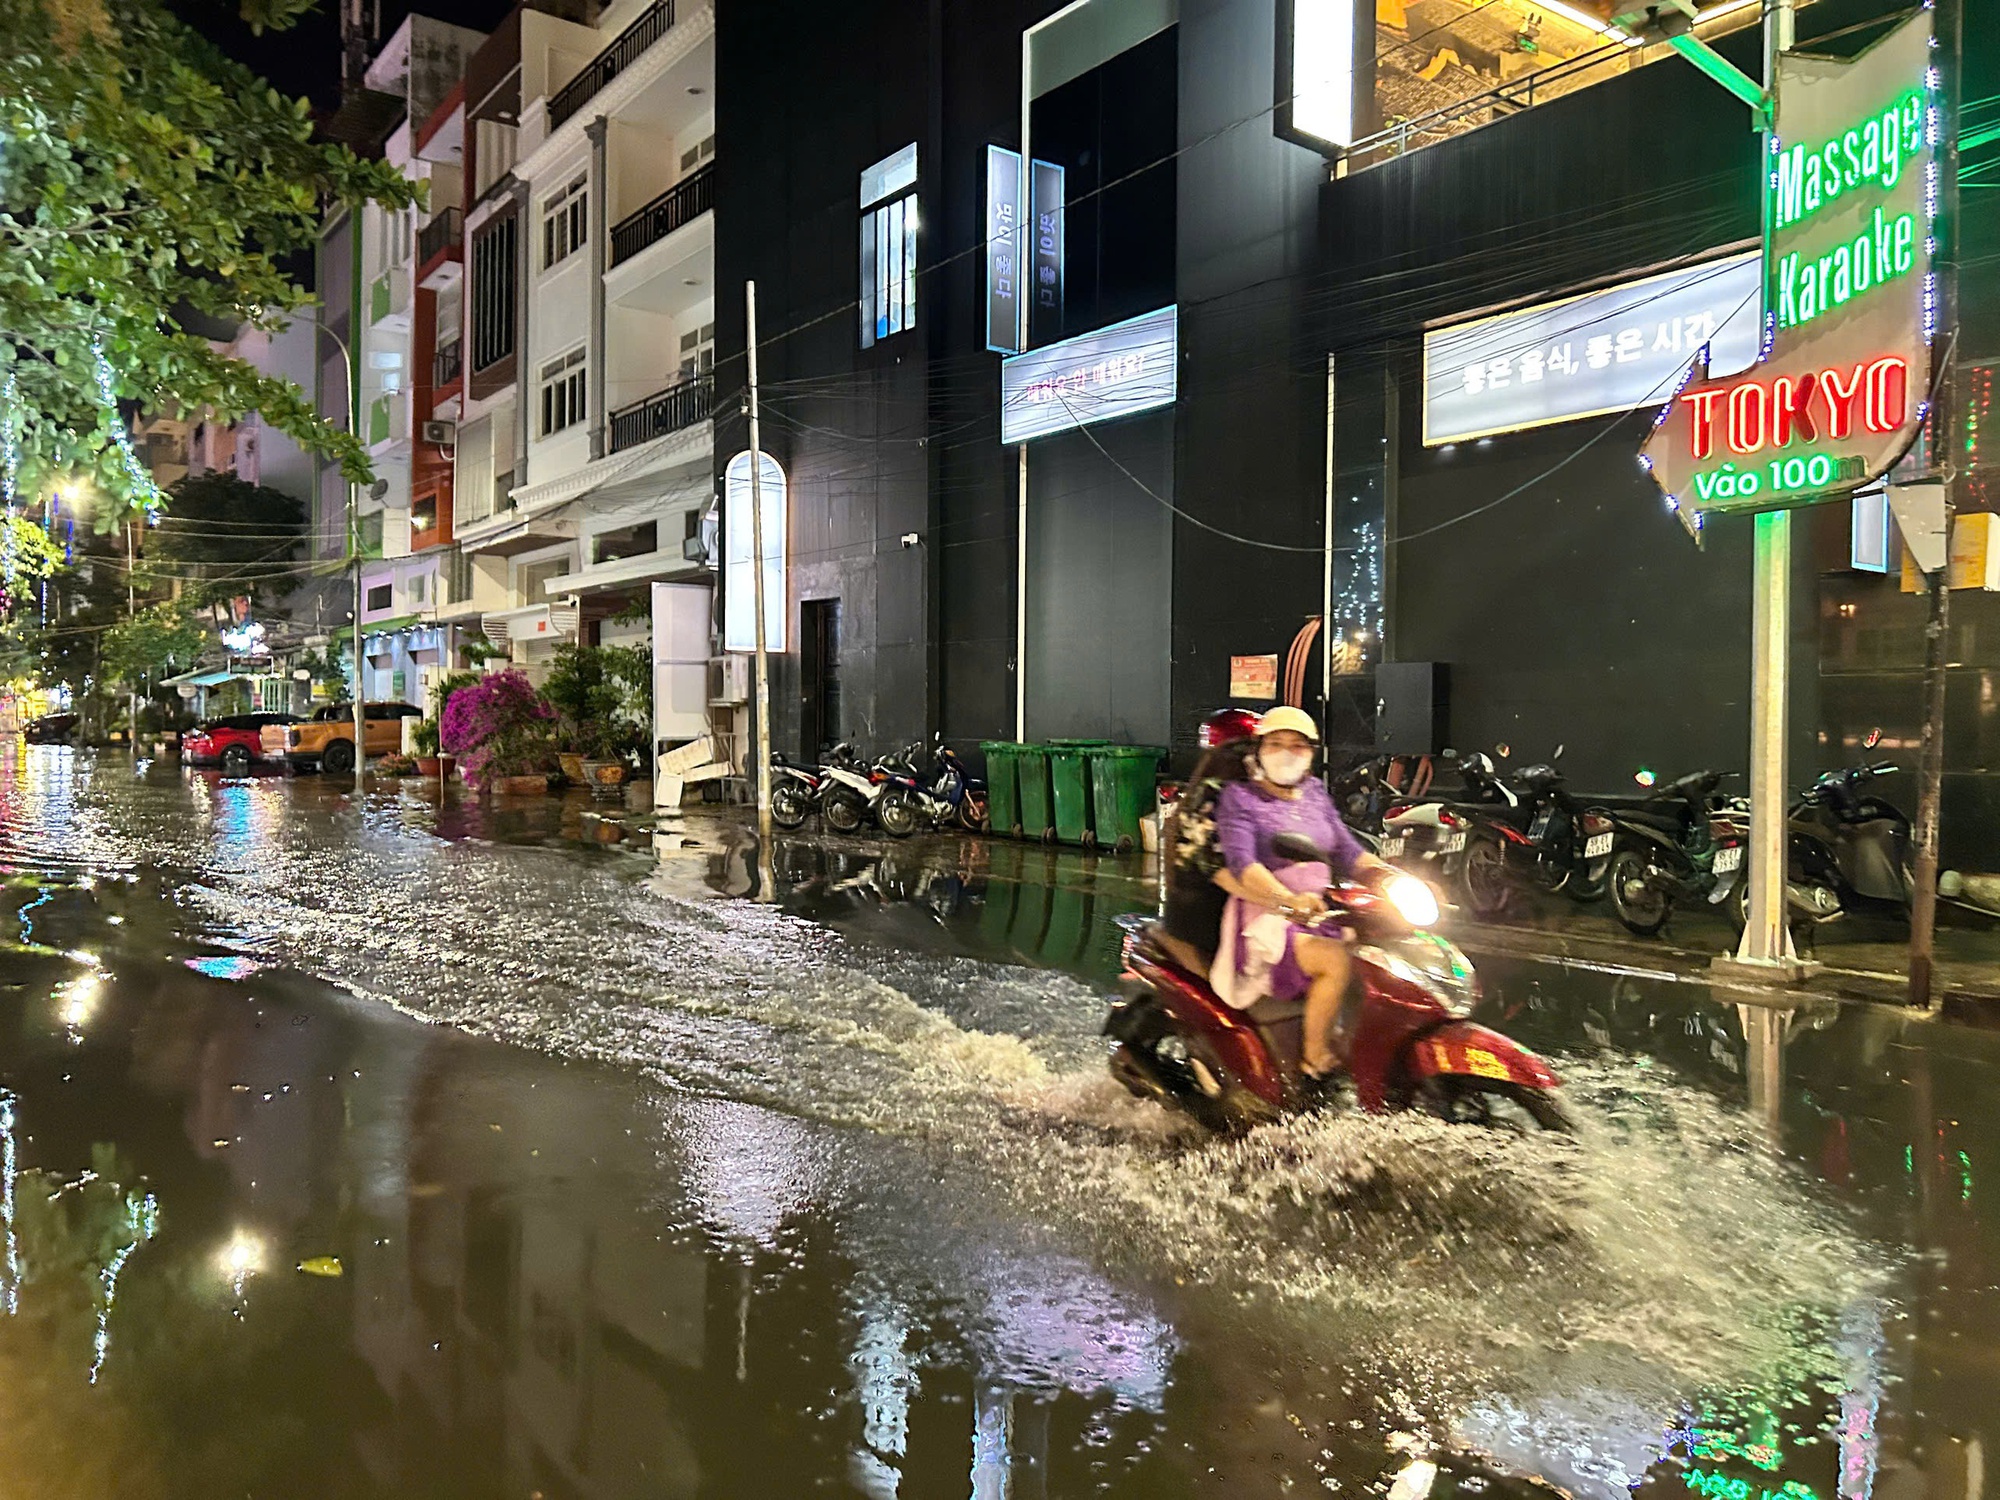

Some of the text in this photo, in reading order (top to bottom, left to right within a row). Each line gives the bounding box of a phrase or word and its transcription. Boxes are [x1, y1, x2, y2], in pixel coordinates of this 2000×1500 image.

[1776, 93, 1923, 230] Massage
[995, 255, 1012, 299] 좋다
[1778, 206, 1914, 329] Karaoke
[1462, 310, 1716, 395] 좋은 음식, 좋은 시간
[1681, 357, 1907, 460] TOKYO
[1695, 462, 1759, 500] Vào
